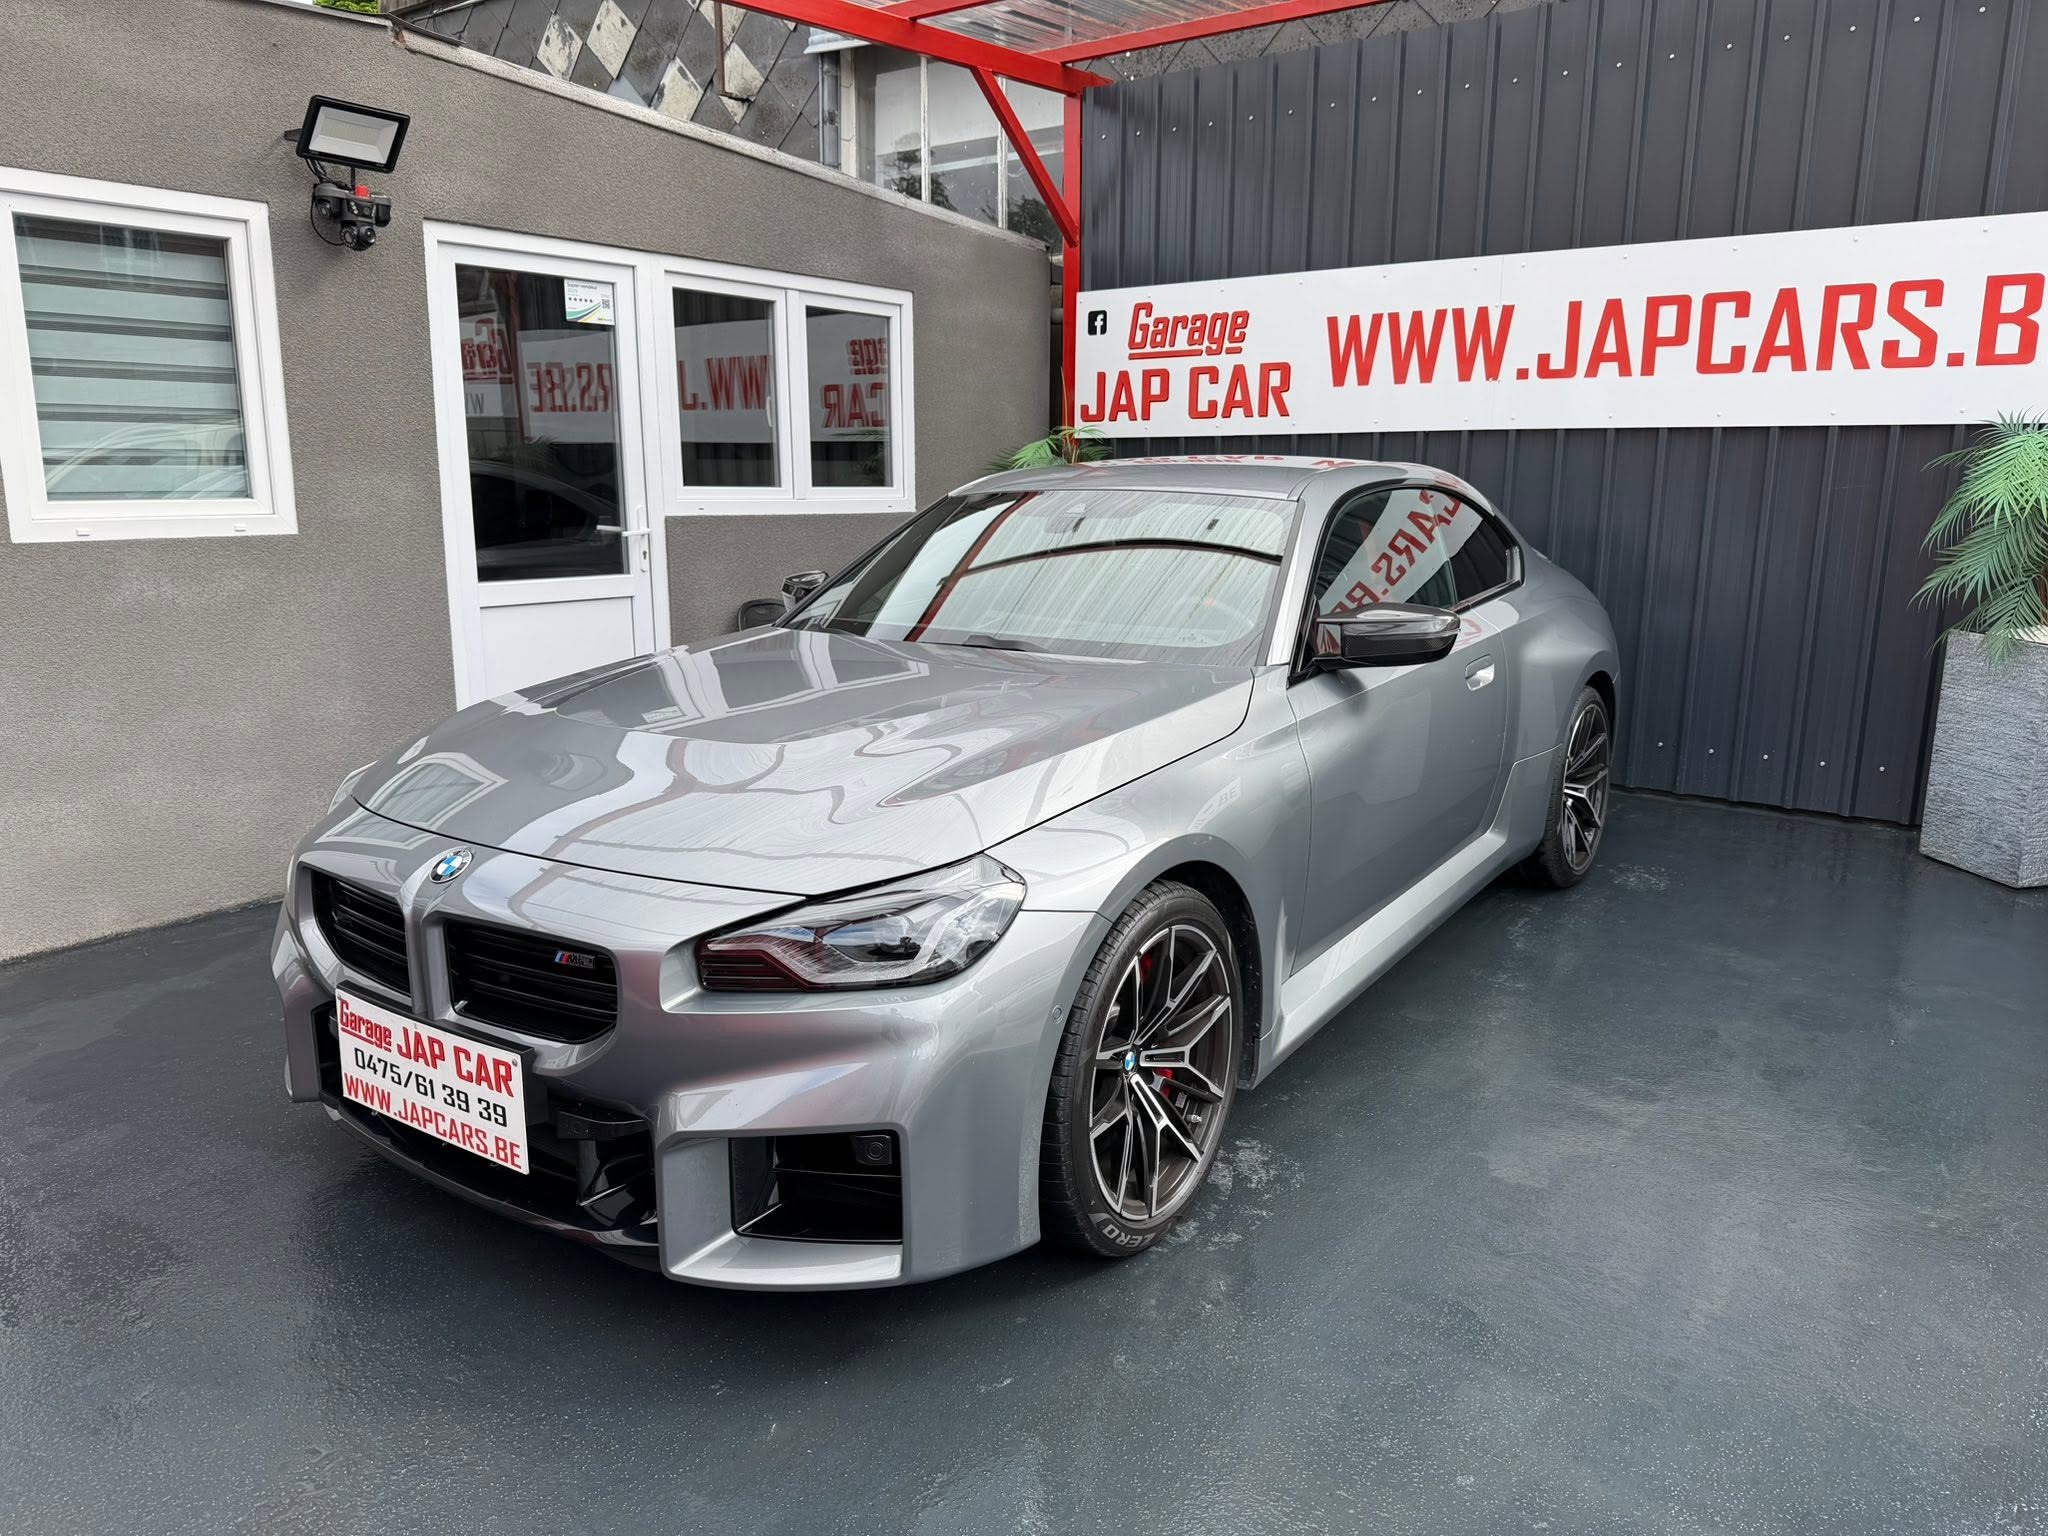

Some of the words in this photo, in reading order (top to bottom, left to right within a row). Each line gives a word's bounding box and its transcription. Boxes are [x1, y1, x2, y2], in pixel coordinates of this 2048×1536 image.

[1127, 301, 1251, 358] Garage
[1326, 272, 2046, 388] WWW.JAPCARS.B
[1080, 368, 1170, 422] JAP
[1187, 361, 1292, 419] CAR
[339, 1000, 392, 1050] Garage
[397, 1027, 446, 1069] JAP
[453, 1045, 514, 1097] CAR
[354, 1047, 435, 1099] 0475/61
[442, 1083, 470, 1113] 39
[477, 1097, 507, 1127] 39
[344, 1072, 521, 1169] WWW.JAPCARS.BE
[1102, 1224, 1156, 1247] ZERO
